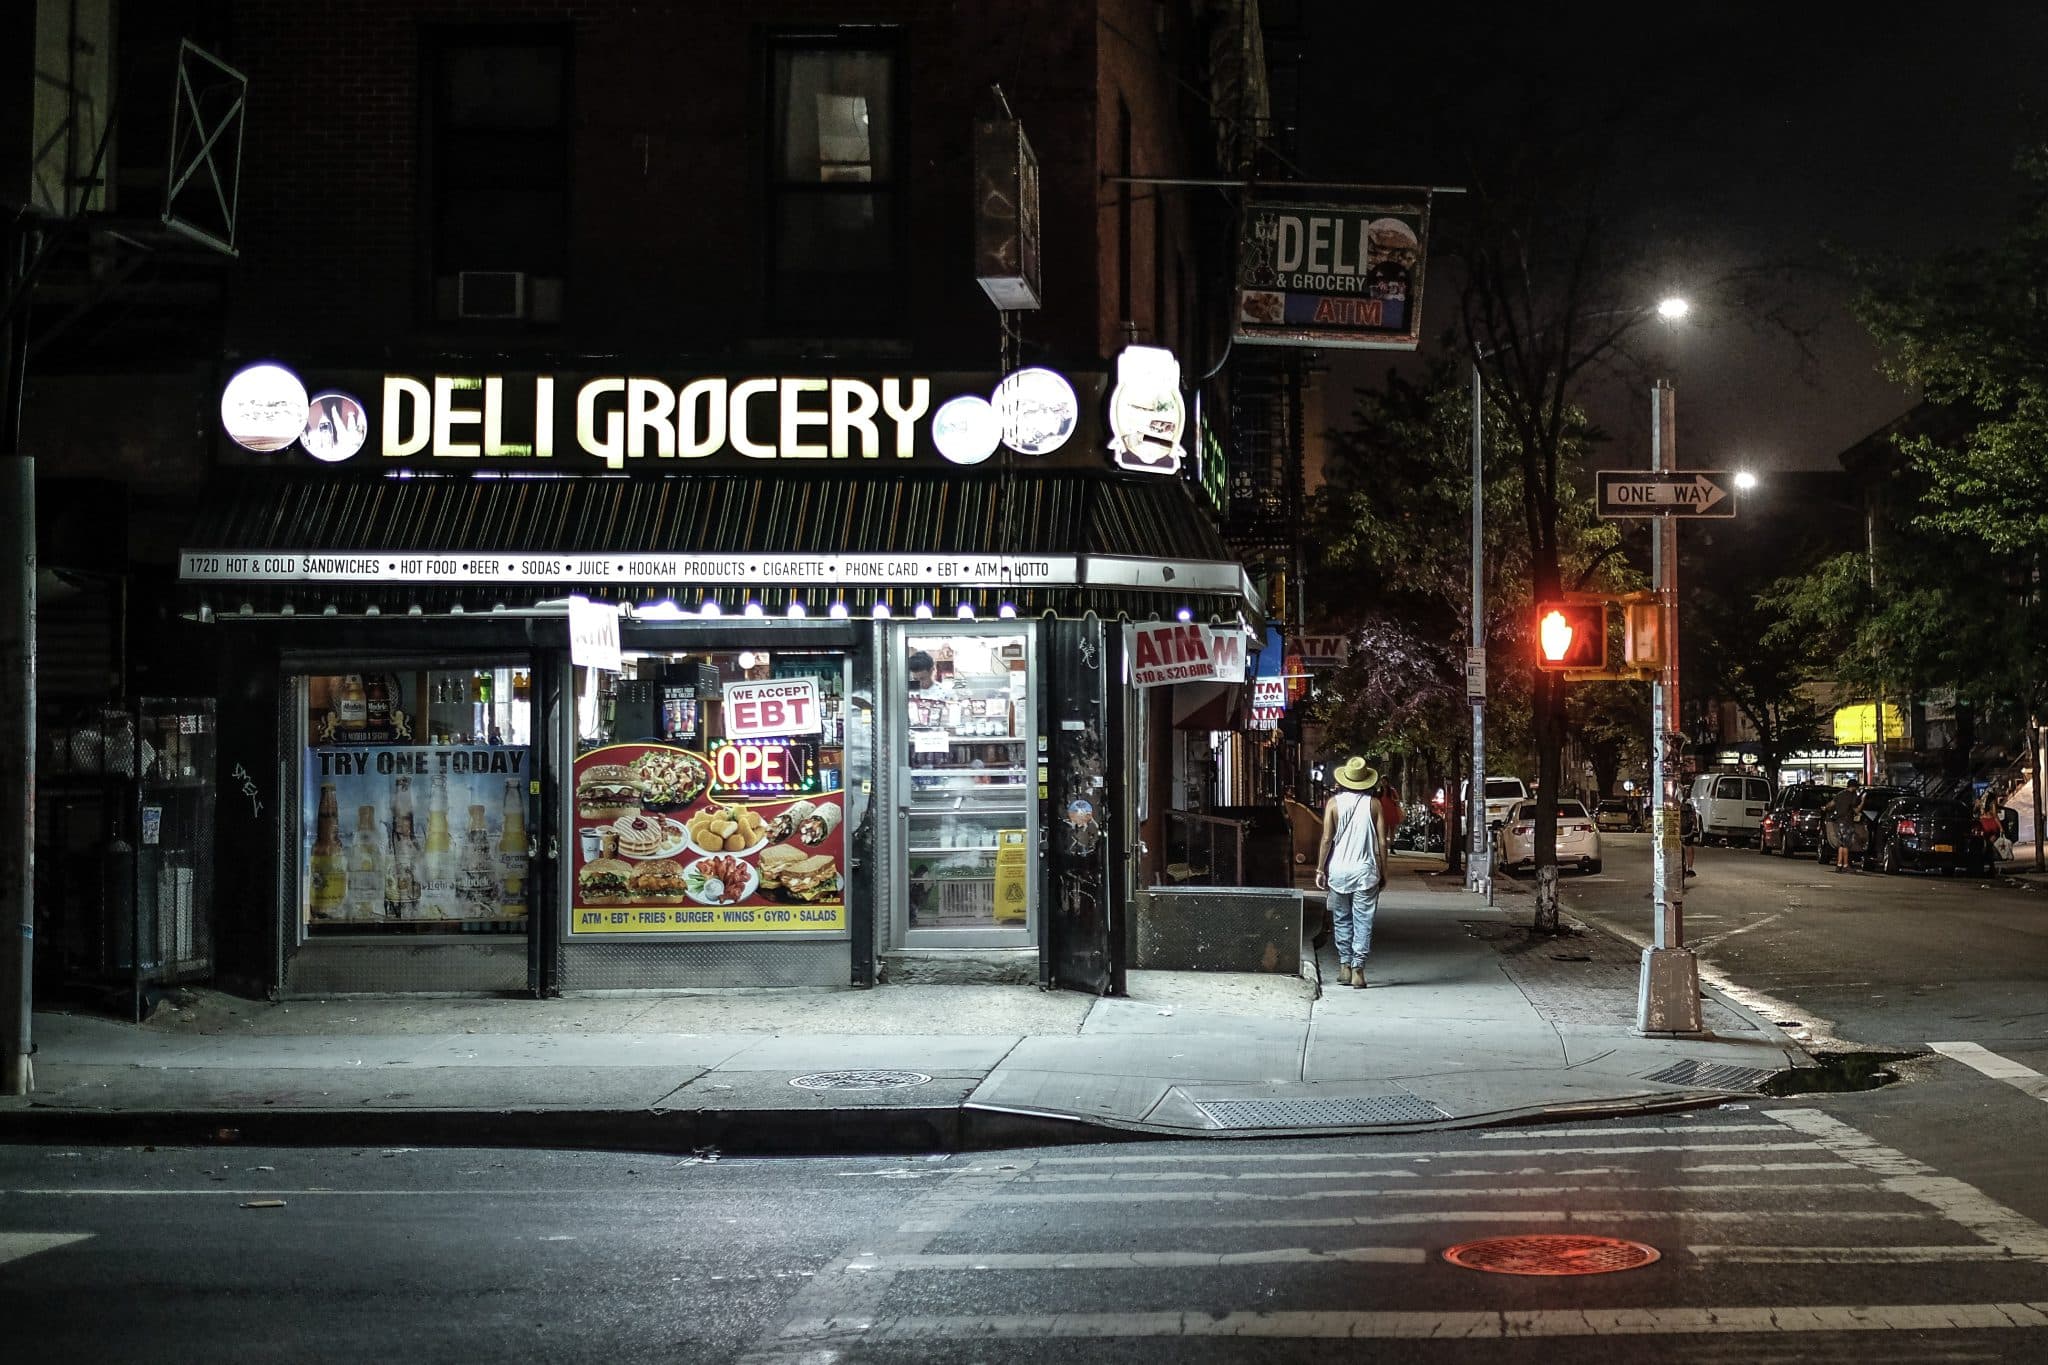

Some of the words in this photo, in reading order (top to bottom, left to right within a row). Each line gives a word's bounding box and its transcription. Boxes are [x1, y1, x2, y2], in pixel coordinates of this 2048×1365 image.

[1277, 215, 1369, 275] DELI
[1276, 273, 1287, 288] &
[1293, 273, 1366, 292] GROCERY
[1313, 297, 1382, 327] ATM
[382, 377, 554, 457] DELI
[576, 377, 930, 469] GROCERY
[1617, 486, 1656, 503] ONE
[1673, 486, 1713, 503] WAY
[226, 558, 248, 573] HOT
[252, 558, 260, 573] &
[264, 558, 295, 573] COLD
[303, 558, 380, 576] SANDWICHES
[401, 559, 423, 574] HOT
[426, 560, 457, 575] FOOD
[470, 560, 499, 575] BEER
[522, 561, 560, 575] SODAS
[576, 561, 610, 576] JUICE
[629, 561, 676, 576] HOOKAH
[684, 561, 745, 576] PRODUCTS
[763, 562, 824, 577] CIGARETTE
[845, 562, 884, 577] PHONE
[888, 562, 918, 577] CARD
[938, 562, 958, 577] EBT
[975, 562, 997, 577] ATM
[1014, 562, 1049, 578] LOTTO
[1136, 624, 1208, 669] ATM
[1136, 671, 1155, 684] $10
[1157, 672, 1166, 681] &
[1167, 667, 1187, 680] $20
[733, 690, 753, 700] WE
[757, 685, 809, 698] ACCEPT
[1256, 682, 1283, 694] TM
[734, 698, 810, 730] EBT
[318, 752, 370, 776] TRY
[376, 751, 428, 775] ONE
[435, 750, 525, 774] TODAY
[717, 746, 805, 784] OPEN
[581, 913, 601, 924] ATM
[610, 913, 629, 924] EBT
[638, 912, 666, 923] FRIES
[675, 911, 714, 923] BURGER
[723, 911, 755, 922] WINGS
[763, 910, 790, 922] GYRO
[799, 910, 836, 922] SALADS
